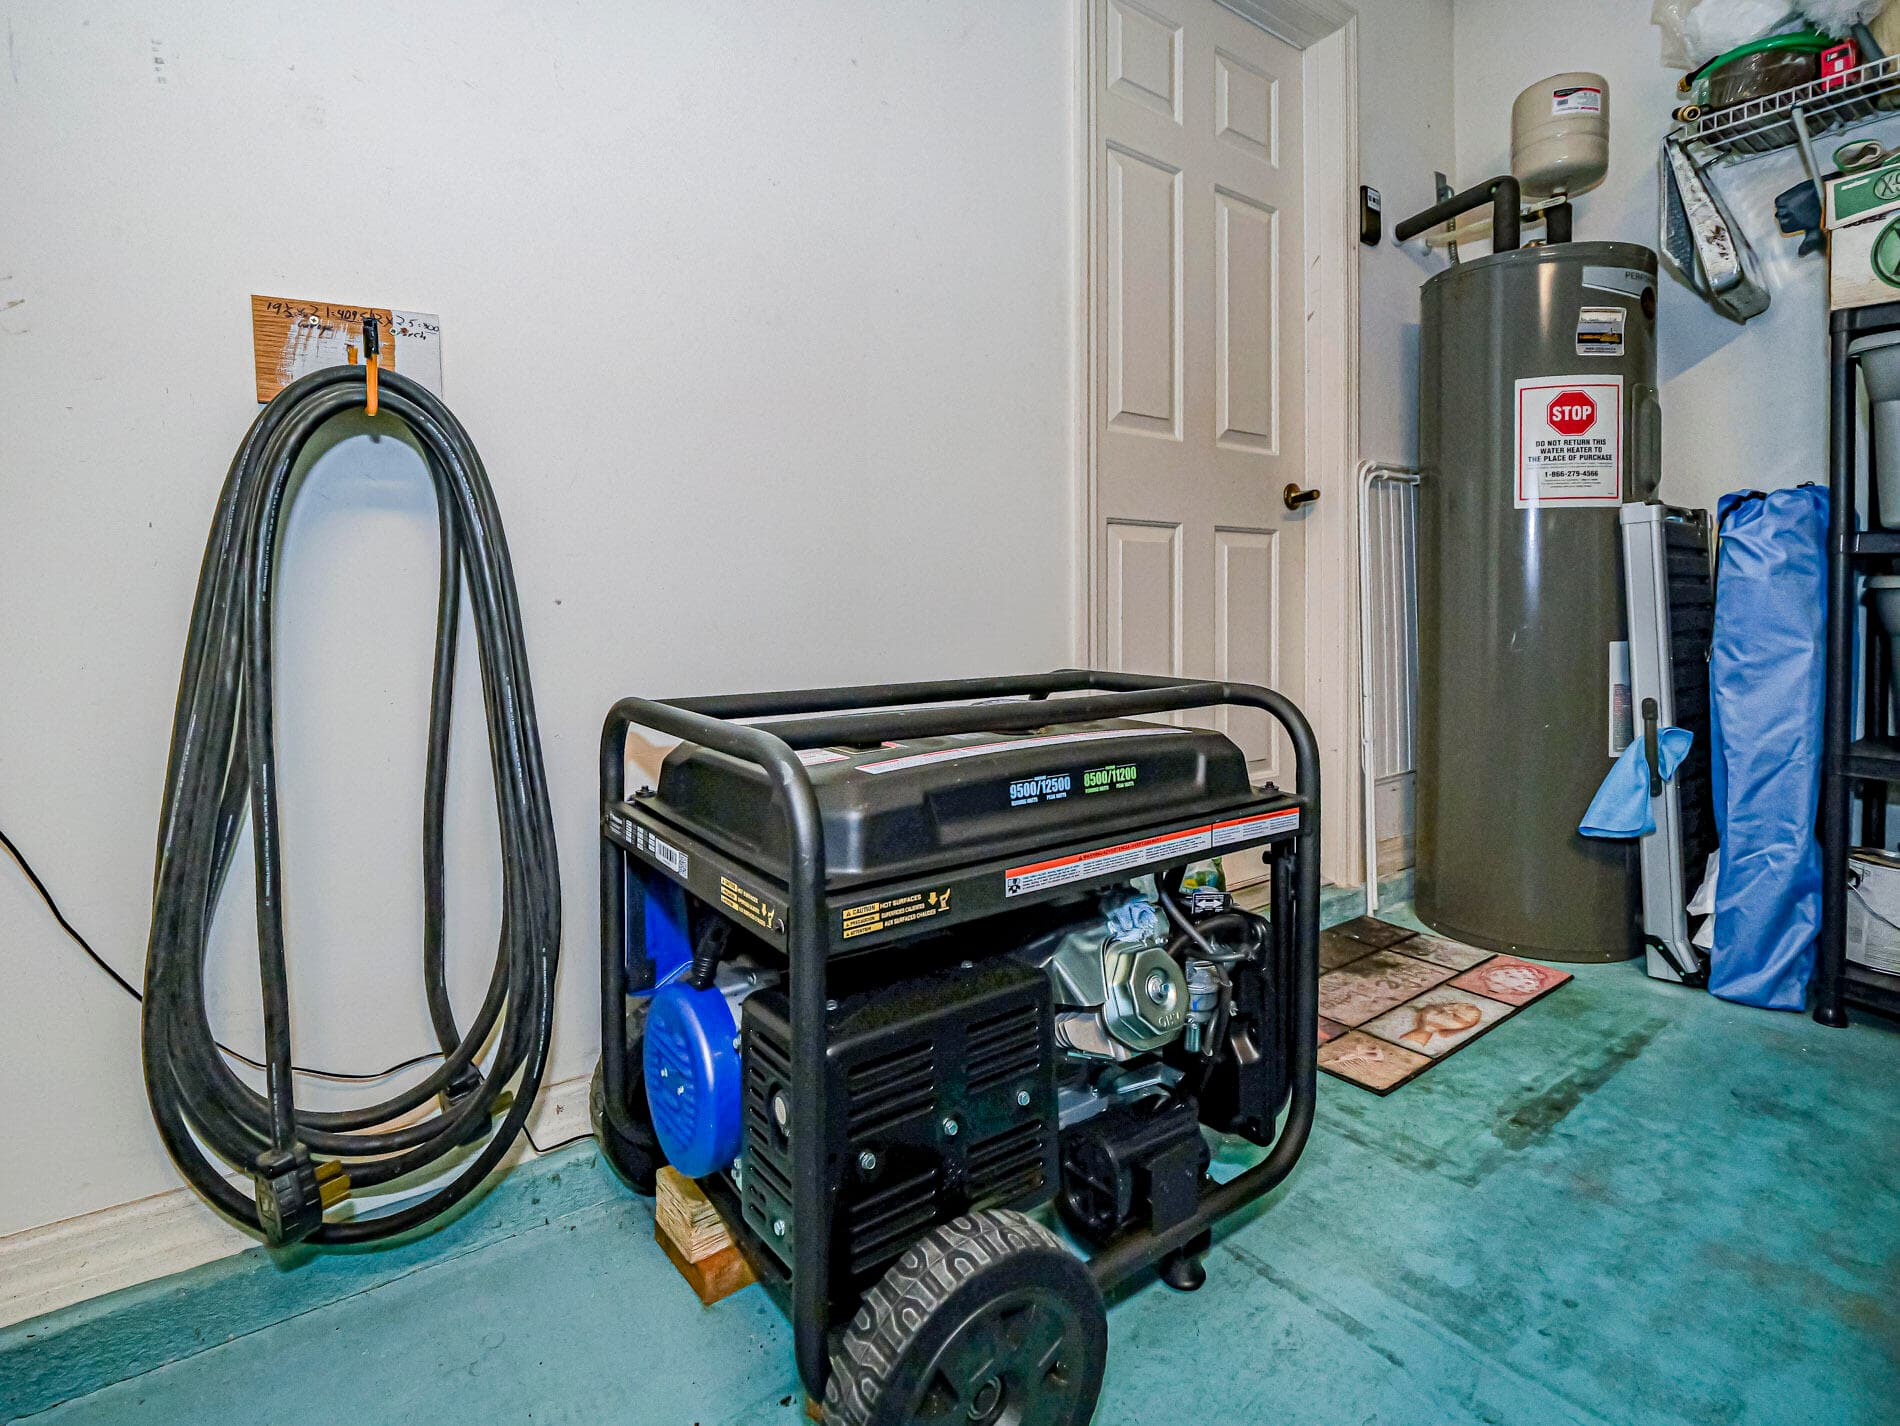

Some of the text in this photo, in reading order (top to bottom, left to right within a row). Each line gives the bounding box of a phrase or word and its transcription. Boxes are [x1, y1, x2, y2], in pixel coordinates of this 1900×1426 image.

[1552, 405, 1592, 421] STOP
[1535, 438, 1606, 447] DO NOT RETURN THIS
[1540, 446, 1564, 455] WATER
[1567, 446, 1593, 454] HEATER
[1579, 453, 1612, 462] PURCHASE
[1009, 777, 1071, 799] 9500/12500
[853, 894, 922, 915] CAUTION HOT SURFACES
